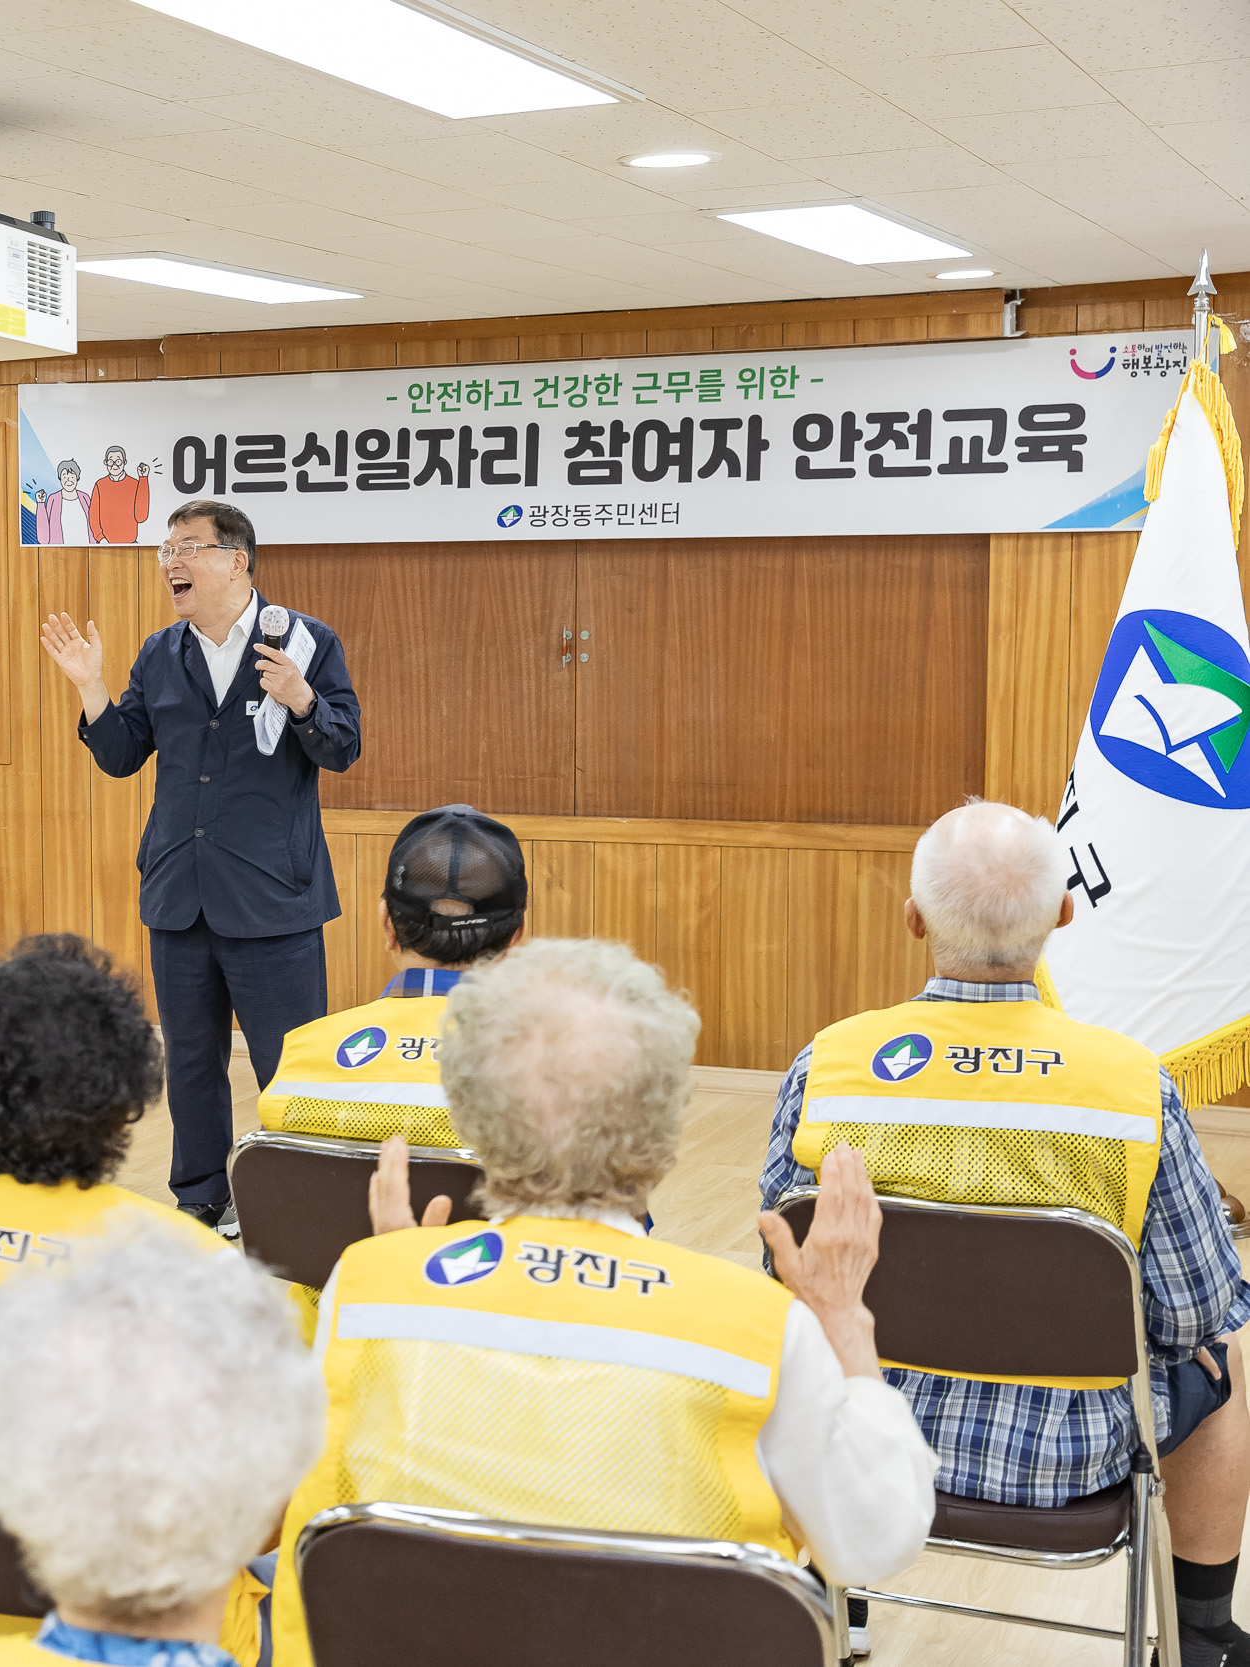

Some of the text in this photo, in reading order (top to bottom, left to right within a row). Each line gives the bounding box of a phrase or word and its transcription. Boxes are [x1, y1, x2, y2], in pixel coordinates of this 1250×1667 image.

[1121, 355, 1188, 378] 행복광진
[407, 380, 522, 414] 안전하고
[533, 374, 623, 409] 건강한
[632, 369, 725, 405] 근무를
[736, 365, 799, 401] 위한
[172, 403, 1089, 495] 어르신일자리 참여자 안전교육
[528, 502, 680, 528] 광장동주민센터
[944, 1045, 1065, 1076] 광진구
[516, 1243, 671, 1295] 광진구
